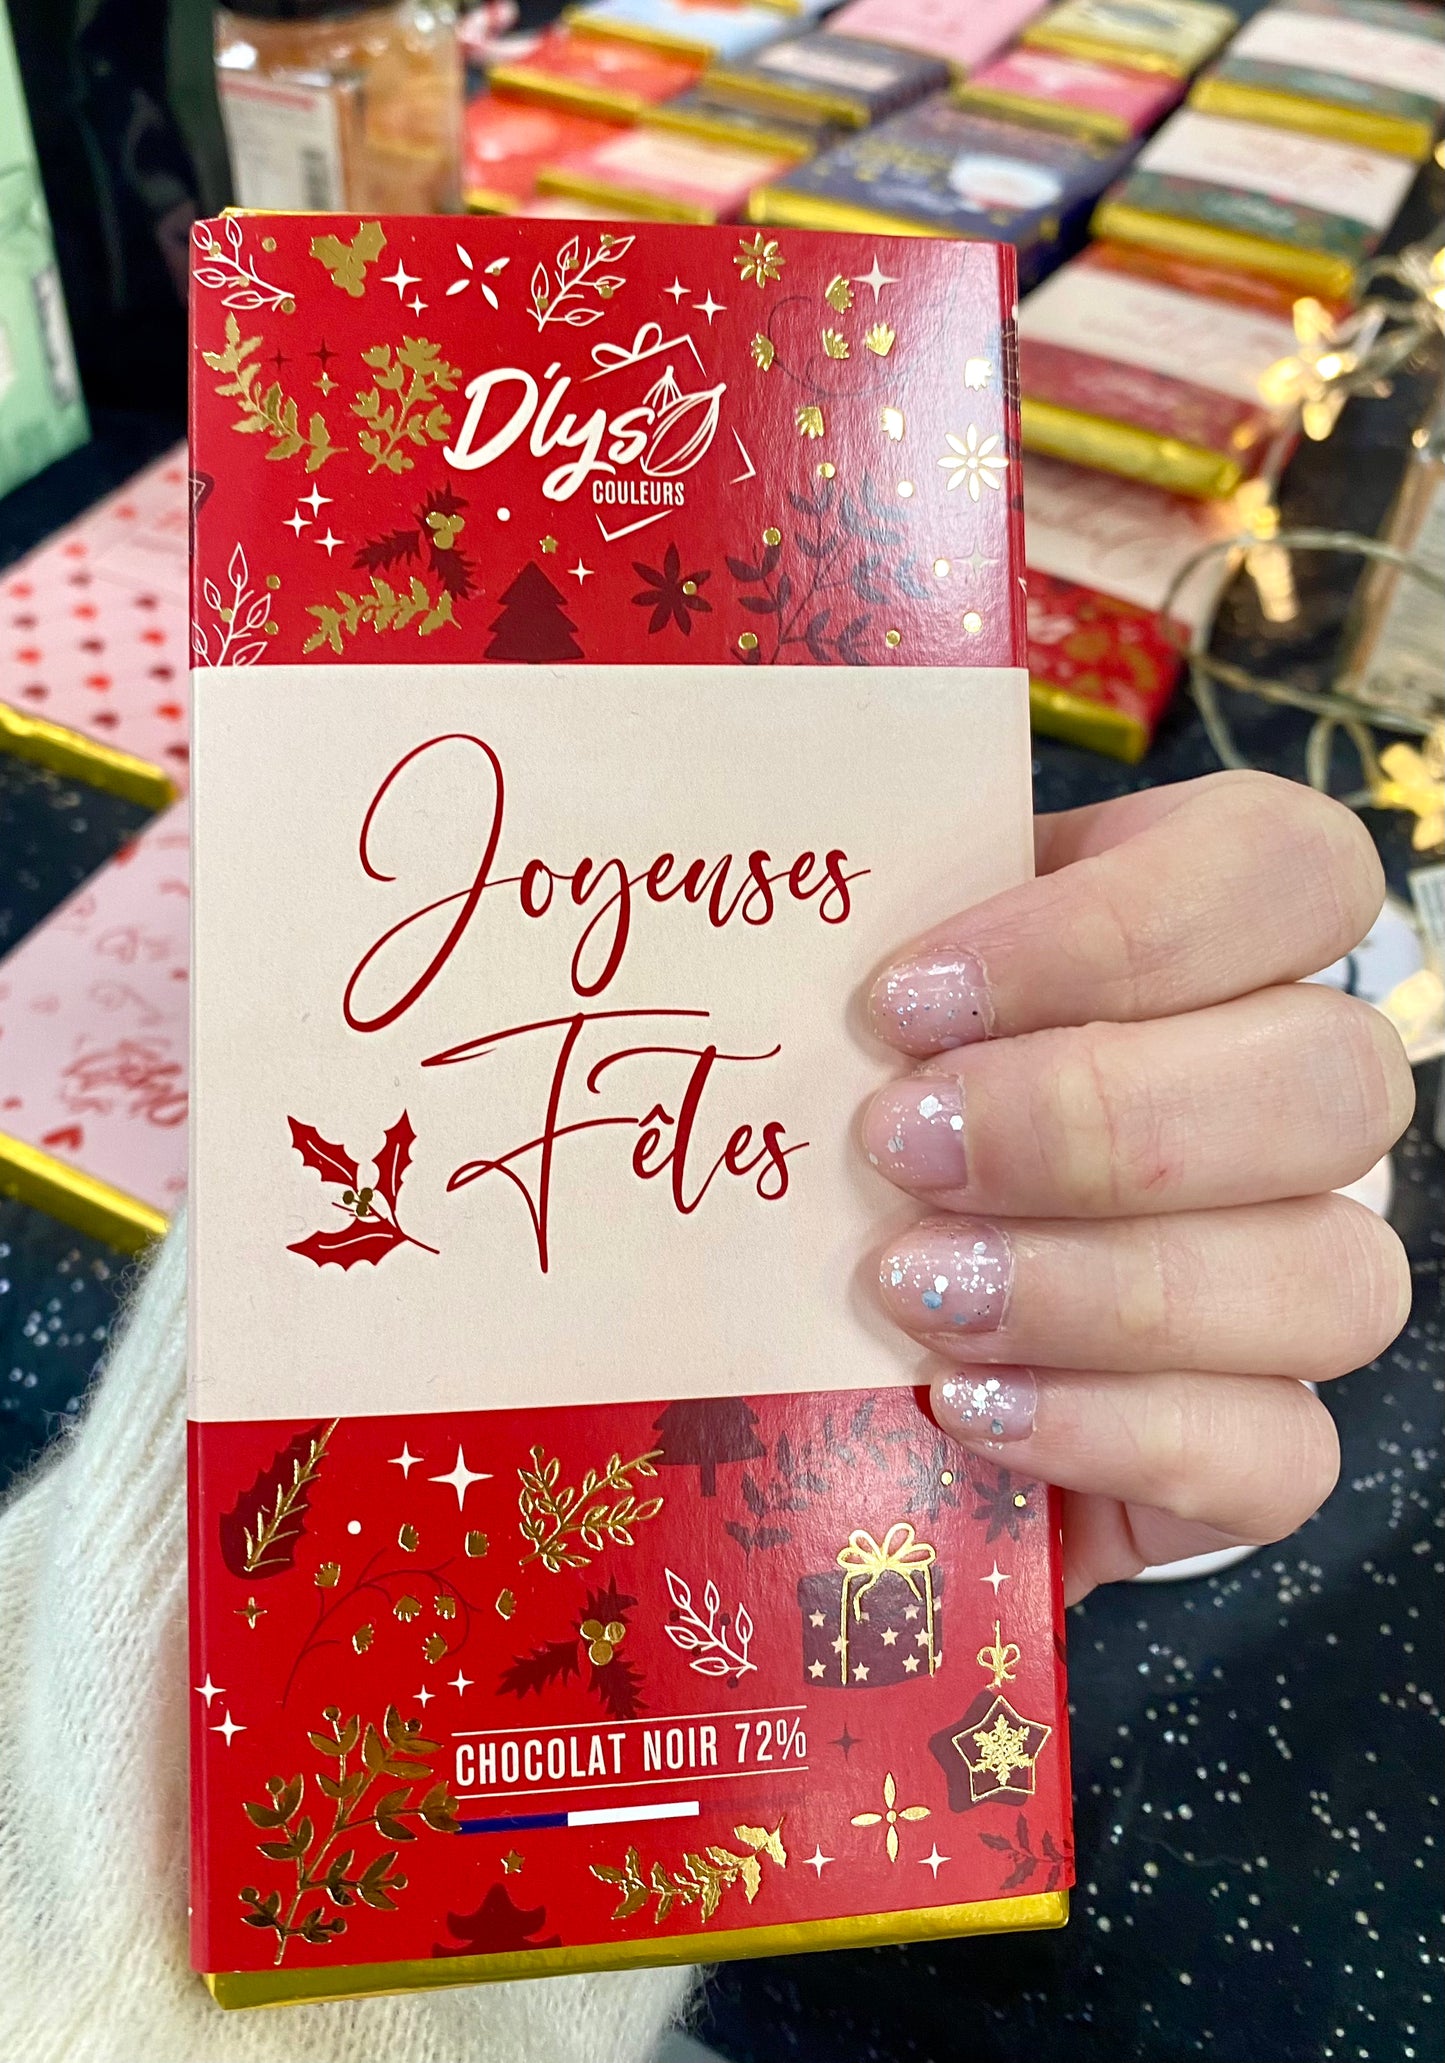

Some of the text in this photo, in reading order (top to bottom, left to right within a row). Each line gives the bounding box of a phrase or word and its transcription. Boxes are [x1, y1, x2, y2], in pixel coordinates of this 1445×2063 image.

[443, 361, 656, 502] D'lys
[592, 479, 685, 506] COULEURS
[343, 733, 872, 1033] Joyeuses
[421, 1009, 810, 1274] Fêtes
[455, 1716, 807, 1787] CHOCOLAT NOIR 72%
